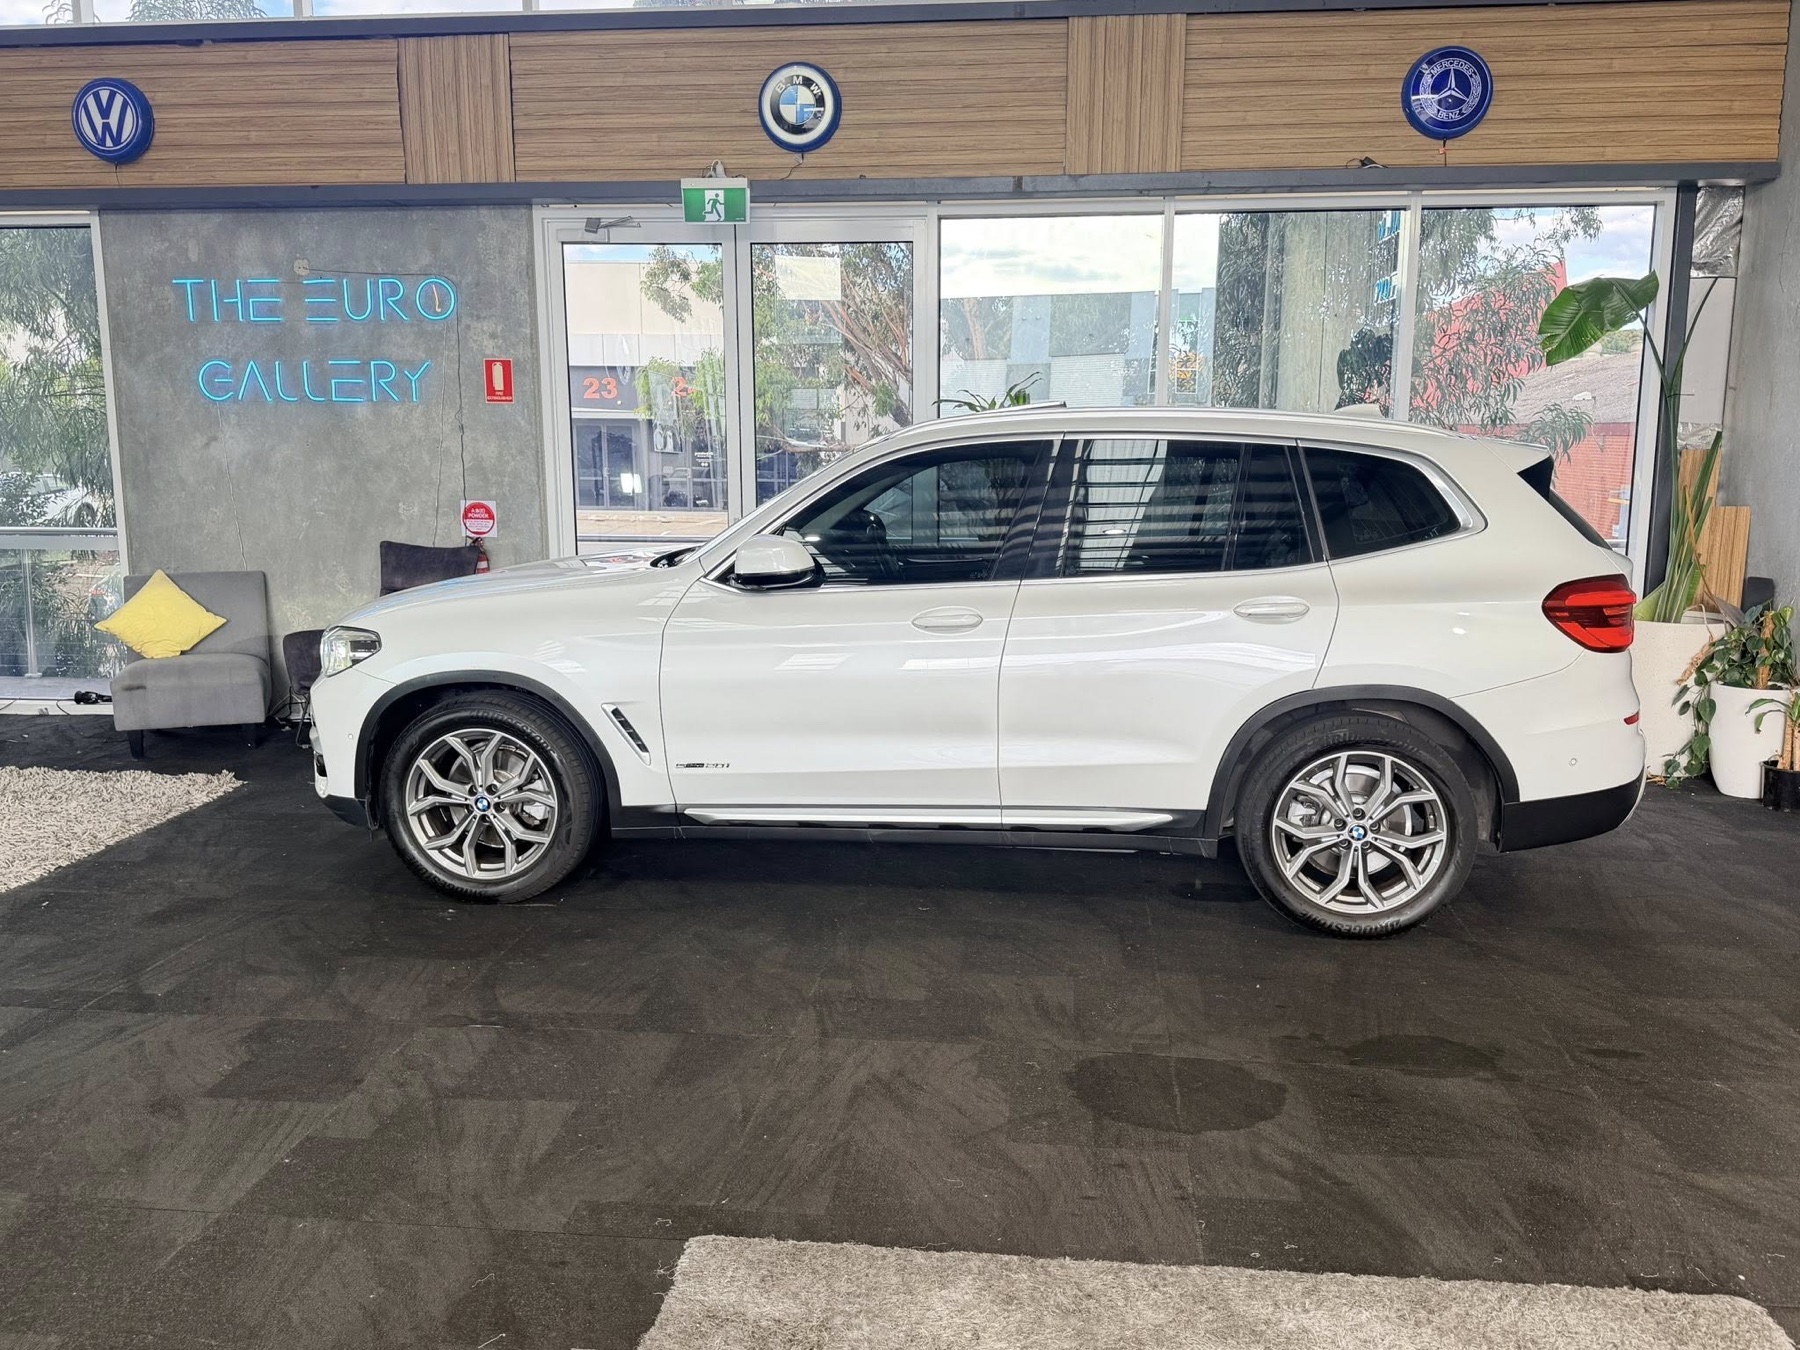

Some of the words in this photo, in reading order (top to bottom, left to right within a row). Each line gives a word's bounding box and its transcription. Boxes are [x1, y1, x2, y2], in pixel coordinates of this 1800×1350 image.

[1430, 60, 1475, 77] MERCEDES
[775, 75, 822, 95] BMW
[80, 87, 136, 150] VW
[1437, 110, 1461, 120] BENZ
[172, 278, 283, 322] THE
[302, 278, 457, 322] EURO
[199, 359, 432, 402] GALLERY
[583, 377, 618, 399] 23
